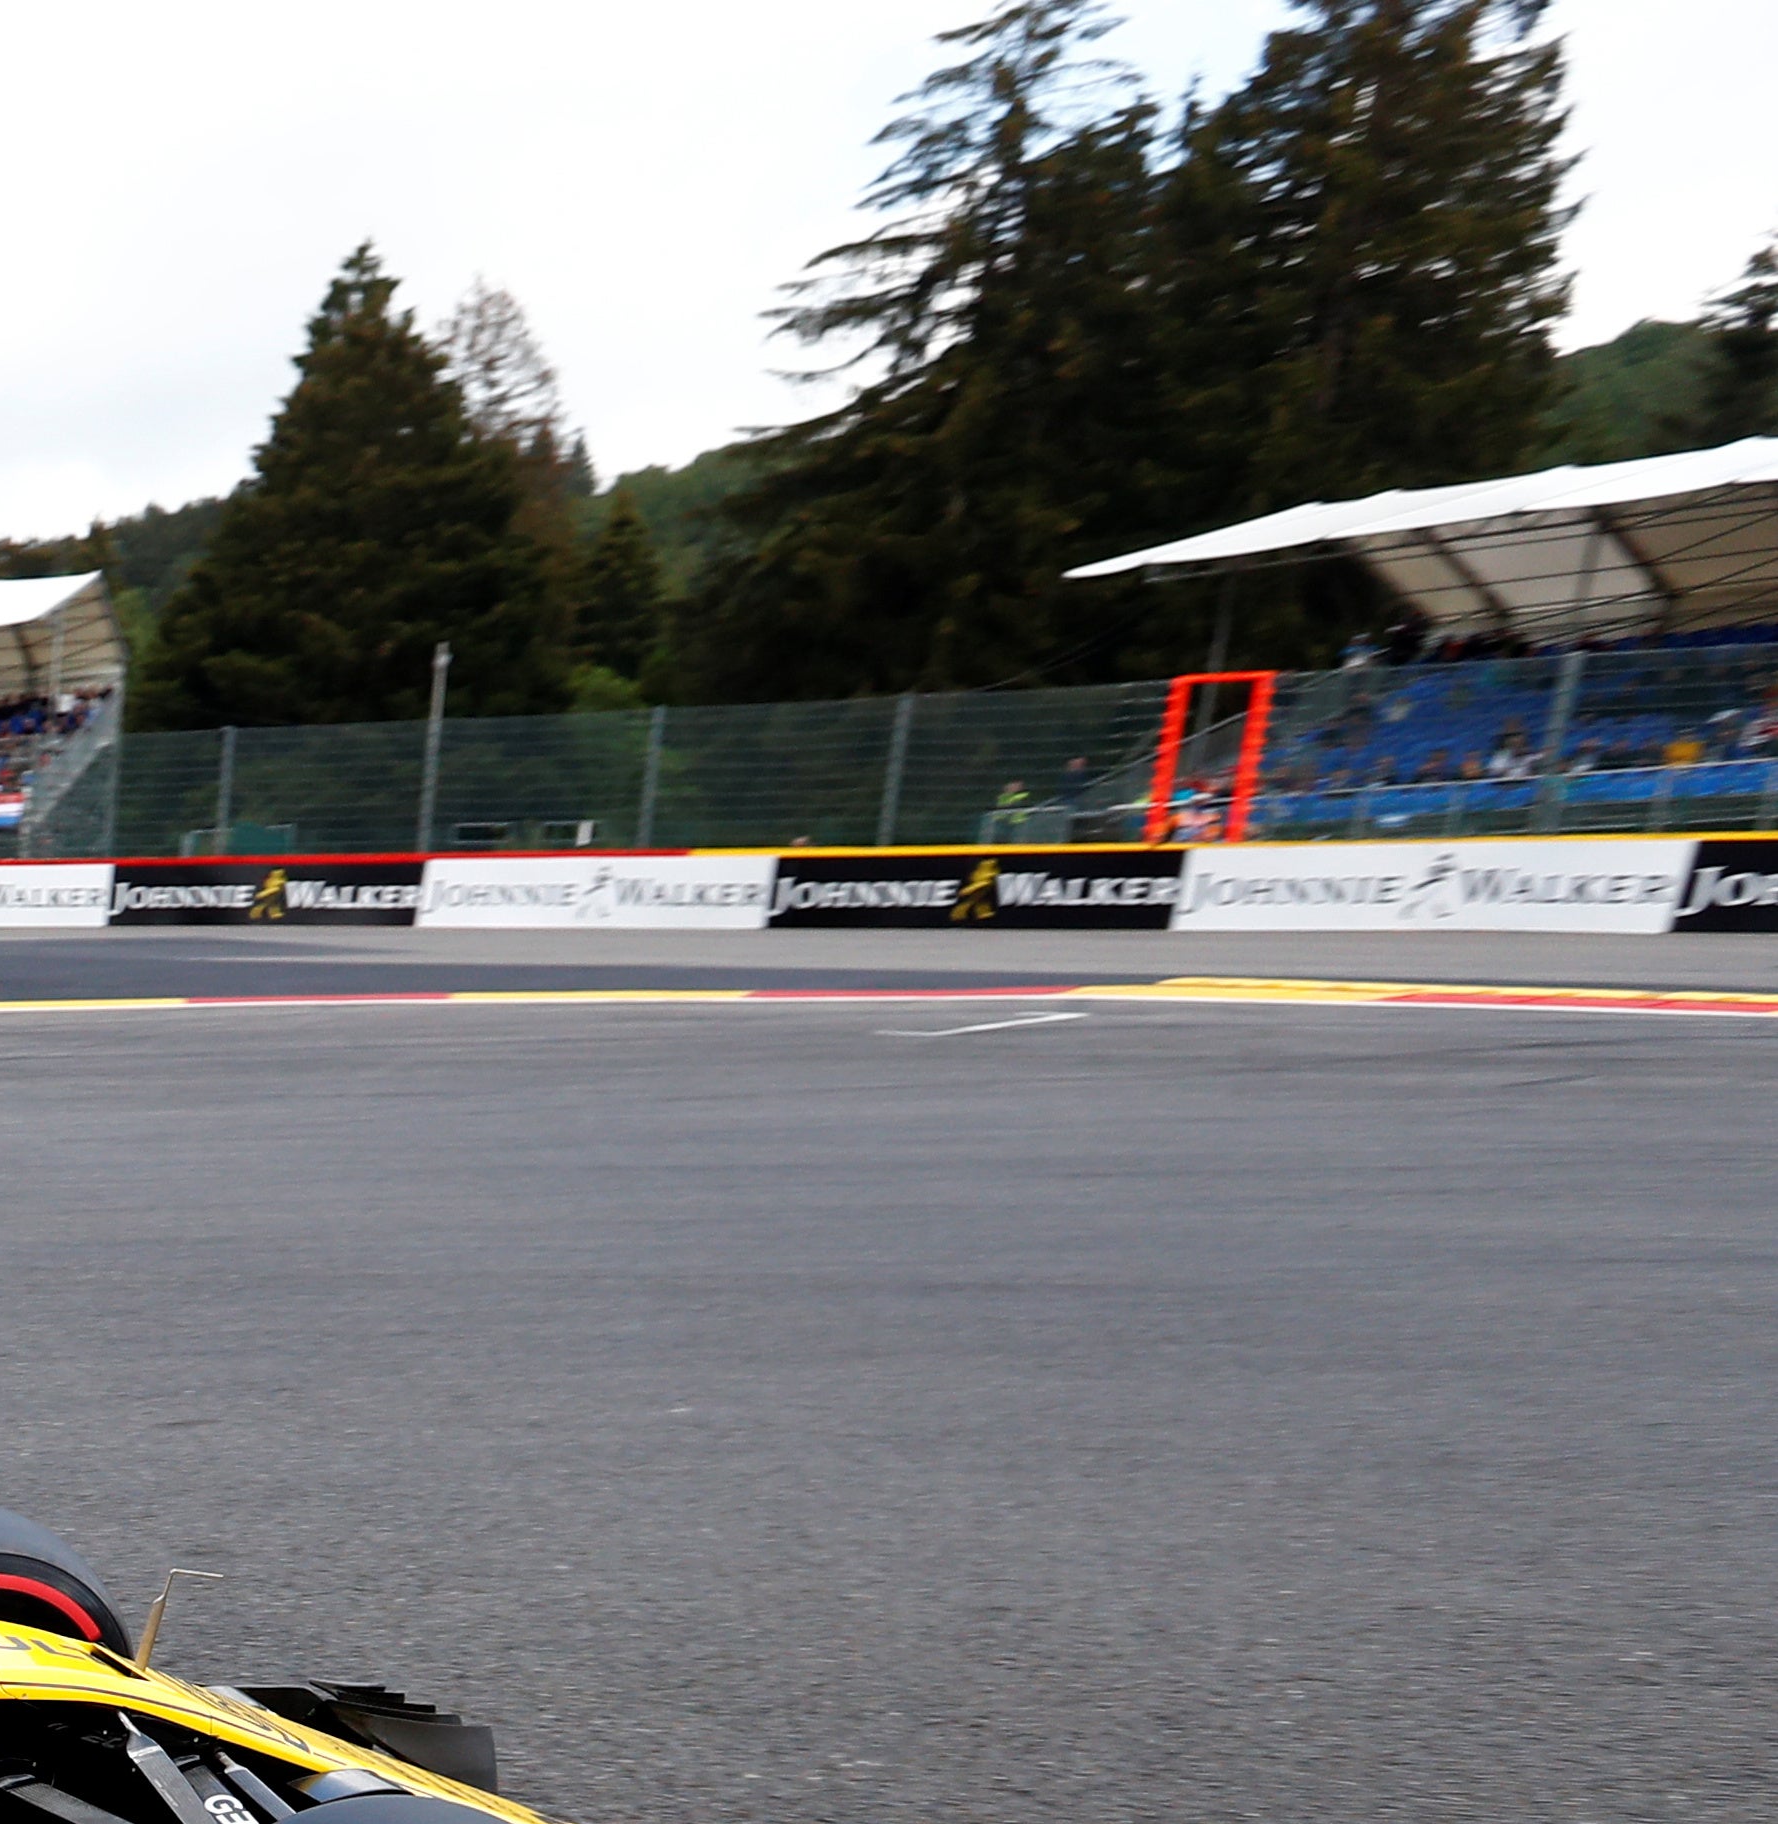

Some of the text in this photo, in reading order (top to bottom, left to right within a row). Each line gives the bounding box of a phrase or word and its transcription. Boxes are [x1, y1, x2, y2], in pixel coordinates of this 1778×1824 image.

[110, 880, 420, 916] JOHNNIE WALKER
[420, 877, 764, 914] JOHNNIE WALKER
[768, 871, 1182, 916] JOHNNIE WALKER
[1175, 871, 1405, 915] JOHNNIE
[1456, 866, 1673, 907] WALKER
